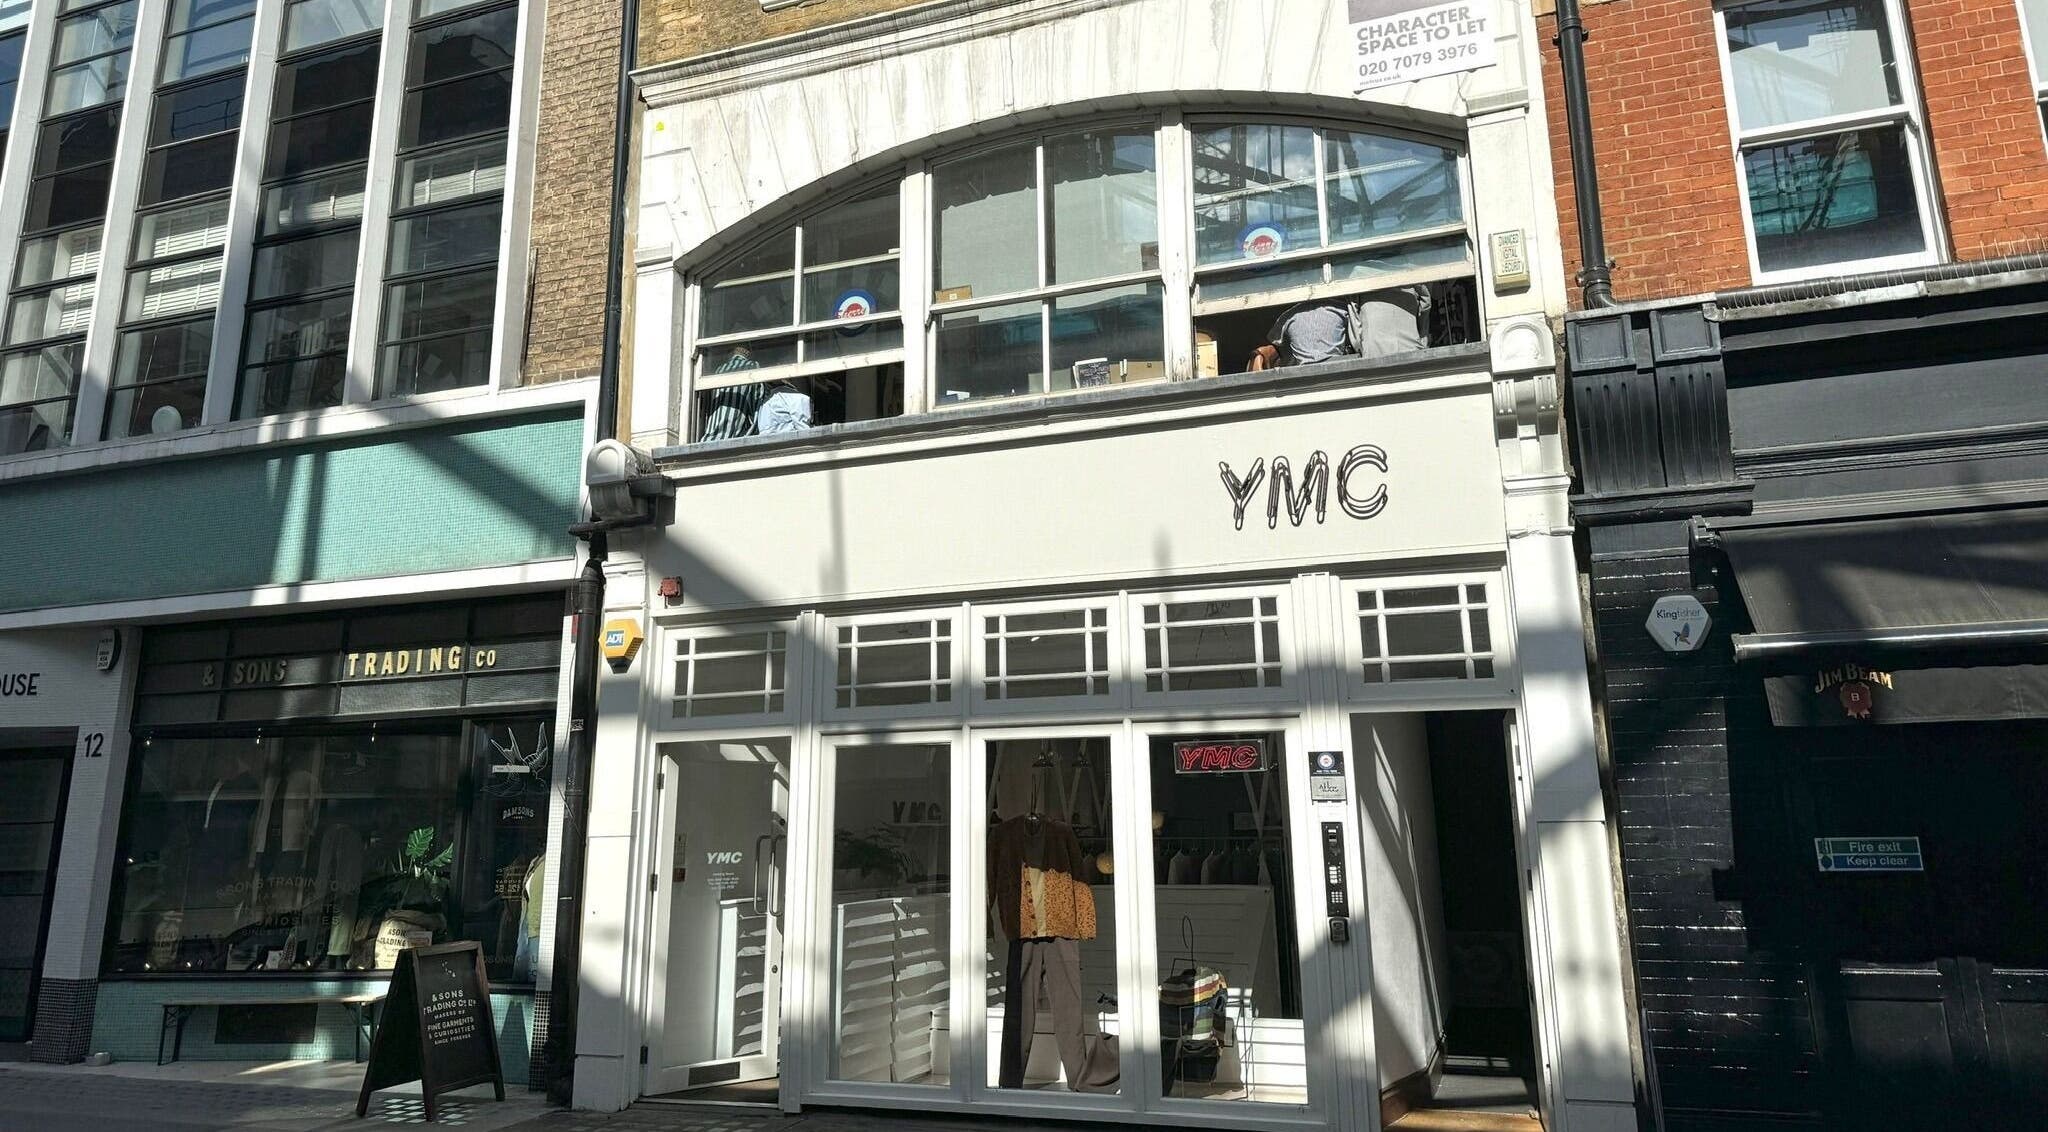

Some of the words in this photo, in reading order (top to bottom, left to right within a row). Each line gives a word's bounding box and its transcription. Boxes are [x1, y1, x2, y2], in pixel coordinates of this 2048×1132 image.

[1357, 6, 1471, 41] CHARACTER
[1357, 32, 1418, 56] SPACE
[1423, 26, 1451, 43] TO
[1456, 18, 1487, 37] LET
[1359, 60, 1388, 77] 020
[1393, 51, 1433, 70] 7079
[1437, 42, 1478, 61] 3976
[1218, 444, 1388, 531] YMC
[605, 633, 625, 644] ADT
[202, 665, 215, 686] &
[233, 659, 288, 684] SONS
[348, 646, 462, 677] TRADING
[475, 649, 496, 668] CO
[0, 673, 40, 696] USE
[1815, 670, 1842, 694] JIM
[1845, 663, 1893, 690] BEAM
[84, 732, 104, 757] 12
[1180, 745, 1258, 770] YMC
[707, 851, 742, 864] YMC
[1849, 842, 1874, 852] Fire
[1878, 842, 1902, 852] exit
[1847, 856, 1876, 867] Keep
[1880, 856, 1908, 866] clear
[423, 1002, 457, 1015] TRADING
[427, 1023, 441, 1031] FINE
[442, 1016, 475, 1029] GARMENTS
[433, 1025, 476, 1038] CURIOSITIES
